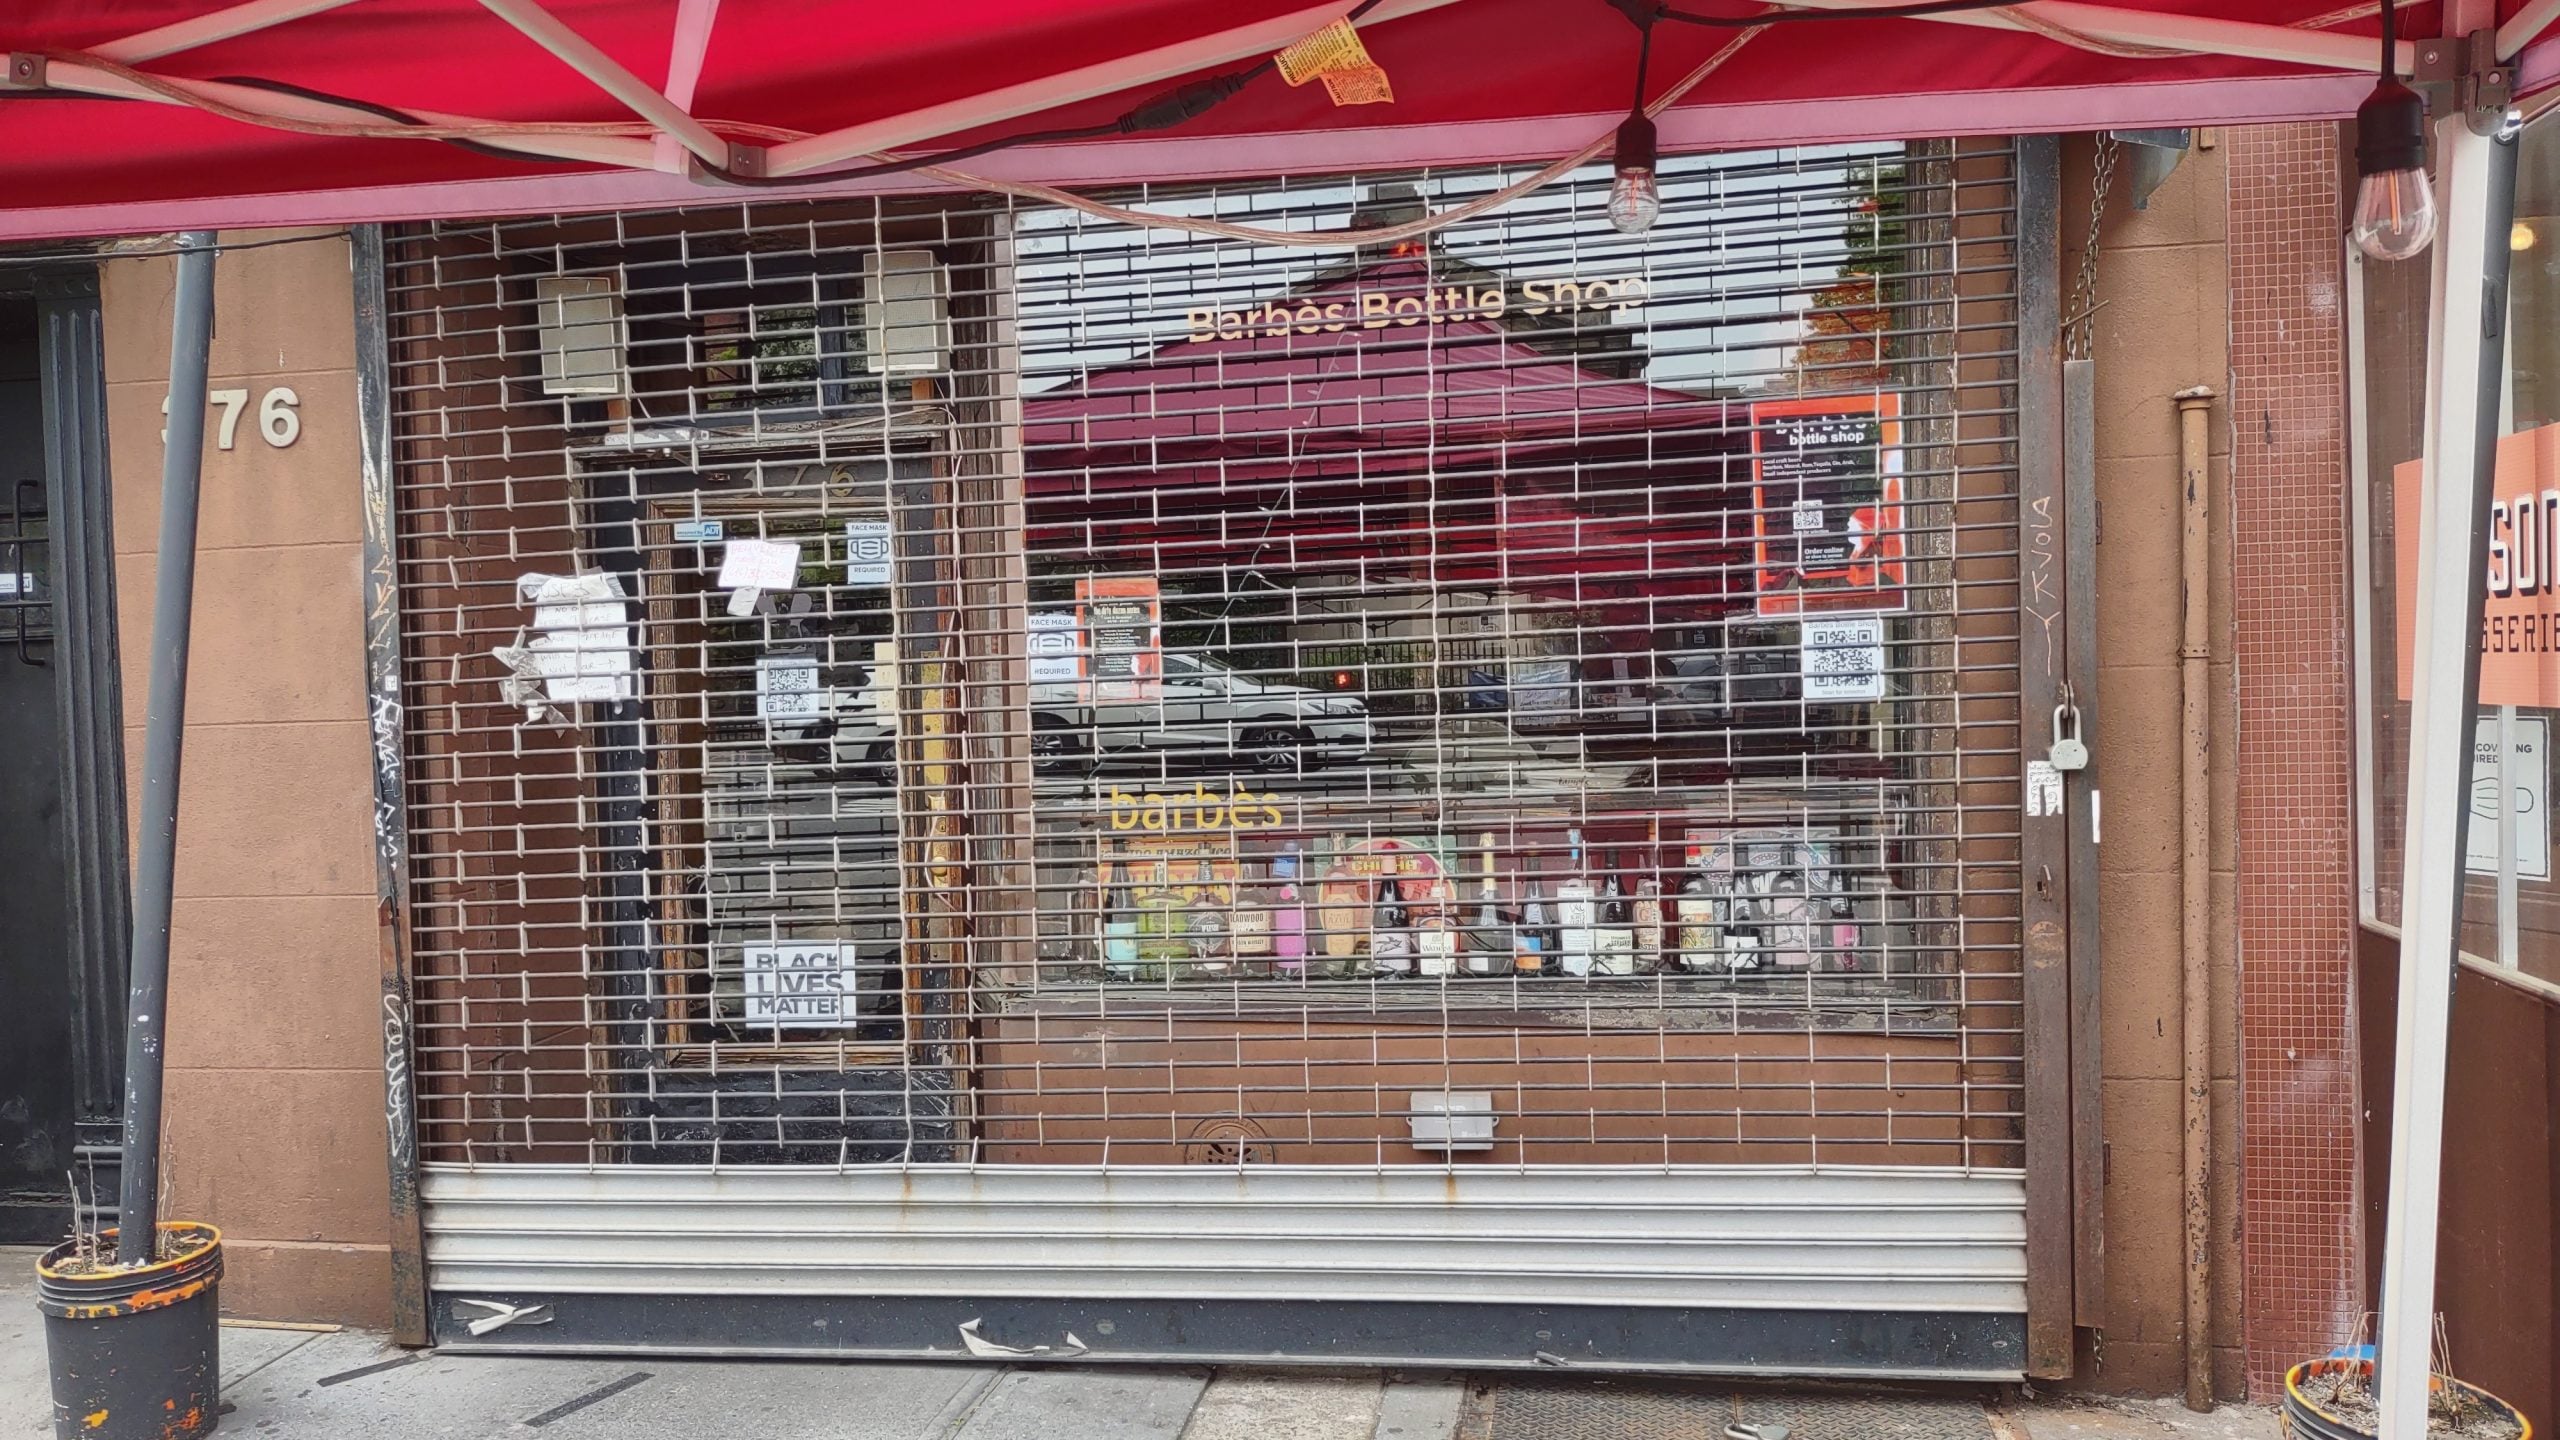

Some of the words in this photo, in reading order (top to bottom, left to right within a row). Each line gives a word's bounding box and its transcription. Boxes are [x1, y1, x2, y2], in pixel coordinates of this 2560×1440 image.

[1188, 299, 1345, 343] Barbès
[1362, 286, 1504, 329] Bottle
[1522, 278, 1648, 317] Shop
[1790, 431, 1827, 445] bottle
[1831, 431, 1864, 443] shop
[705, 526, 719, 535] ADT
[2487, 489, 2560, 592] SON
[1804, 547, 1823, 555] Order
[2476, 743, 2532, 753] COVNG
[2474, 754, 2498, 764] IRED
[1112, 781, 1282, 829] barbès
[1352, 859, 1418, 870] CHIHA
[756, 952, 840, 971] BLACK
[757, 973, 844, 994] LIVES
[758, 998, 844, 1014] MATTER
